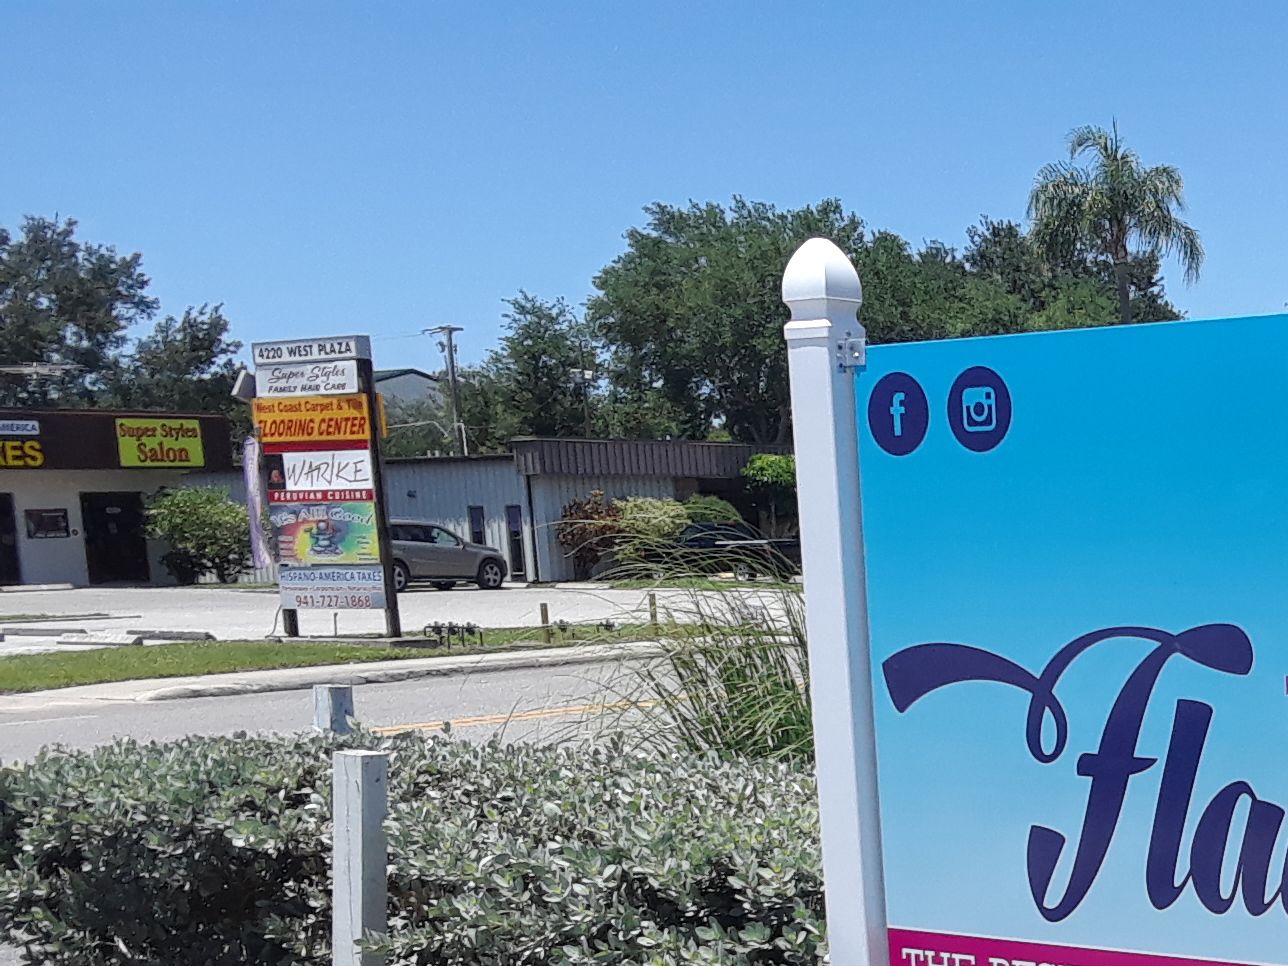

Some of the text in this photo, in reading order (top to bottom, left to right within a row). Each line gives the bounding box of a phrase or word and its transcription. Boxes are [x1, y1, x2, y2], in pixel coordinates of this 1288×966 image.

[258, 341, 352, 360] 4220 WEST PLAZA
[267, 364, 346, 384] Super Styles
[277, 401, 303, 412] Coast
[305, 400, 334, 413] Carpet
[119, 423, 198, 441] Super Styles
[317, 416, 366, 436] CENTER
[136, 441, 191, 463] Salon
[274, 490, 367, 500] PERUVIAN CUISINE
[357, 571, 382, 581] TAXES
[295, 595, 371, 608] 941-727-1868
